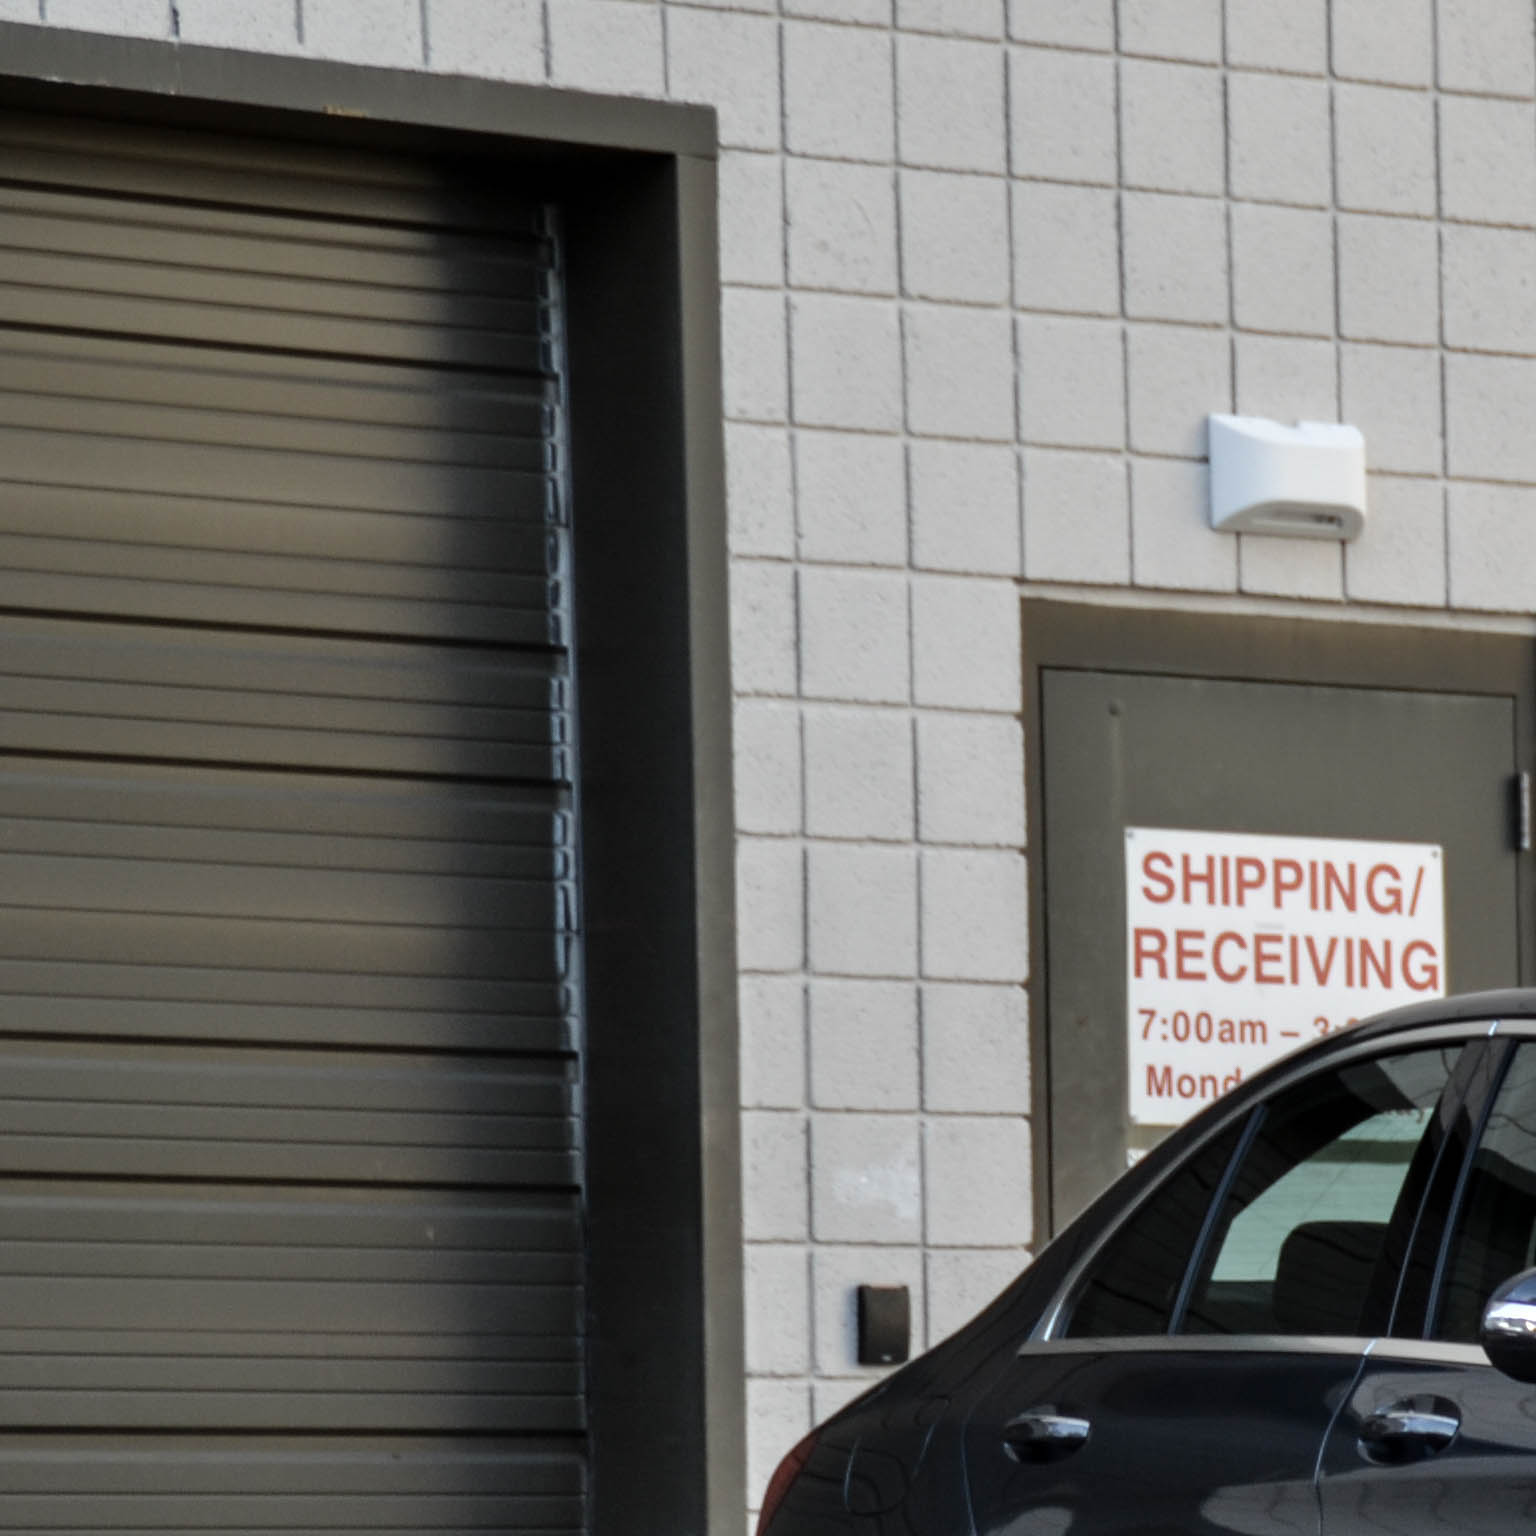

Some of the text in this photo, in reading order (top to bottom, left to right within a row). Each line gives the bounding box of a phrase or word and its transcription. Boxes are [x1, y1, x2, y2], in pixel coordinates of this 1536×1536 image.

[1141, 850, 1425, 917] SHIPPING/
[1133, 927, 1439, 992] RECEIVING
[1138, 1007, 1268, 1045] 7:00am
